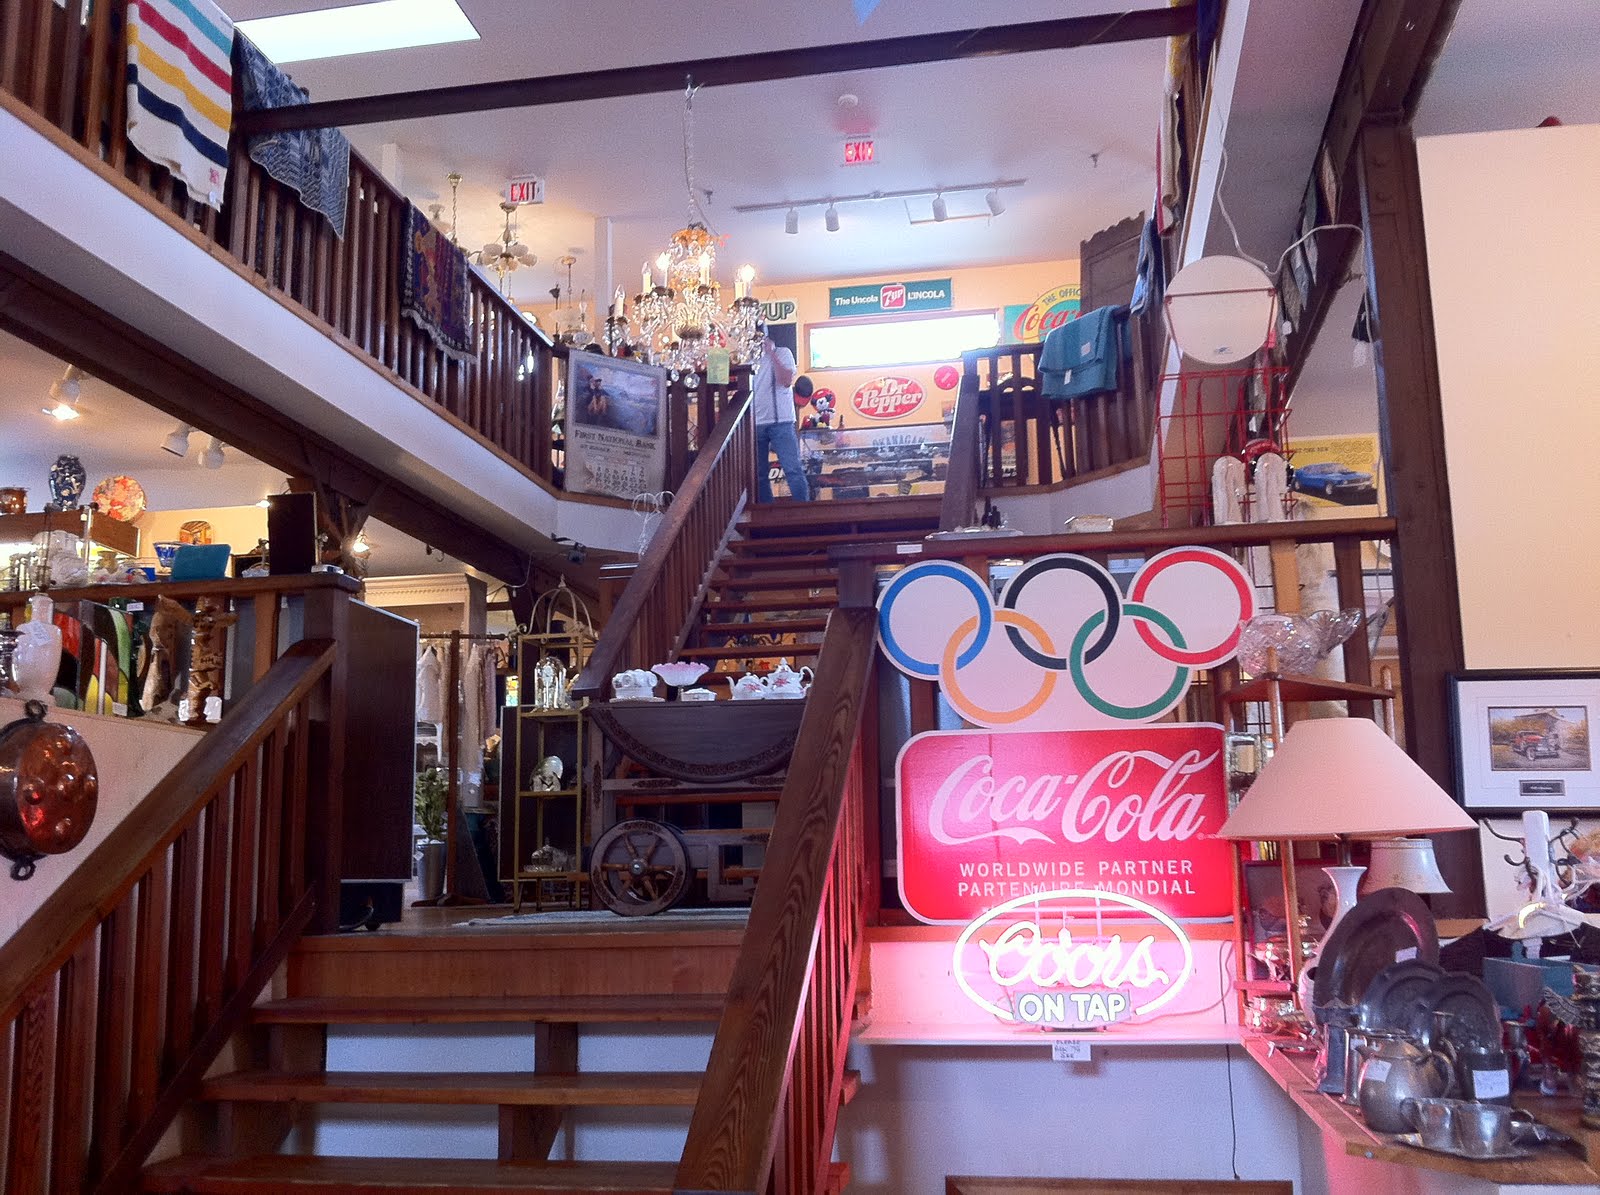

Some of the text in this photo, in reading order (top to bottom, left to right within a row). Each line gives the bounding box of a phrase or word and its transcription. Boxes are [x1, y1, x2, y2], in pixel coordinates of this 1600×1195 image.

[844, 140, 875, 163] EXIT
[510, 181, 538, 203] EXIT
[834, 297, 851, 306] The
[851, 294, 879, 305] Uncola
[882, 288, 904, 307] 7UP
[1042, 293, 1058, 306] THE
[879, 377, 912, 397] Dr
[858, 389, 922, 415] Pepper
[575, 430, 656, 450] FIRST NATIONAL BANK
[928, 748, 1220, 846] Coca-Cola
[960, 859, 1194, 878] WORLDWIDE PARTNER
[1098, 878, 1196, 897] MONDIAL
[978, 920, 1170, 988] Coors
[1018, 993, 1127, 1022] ON TAP
